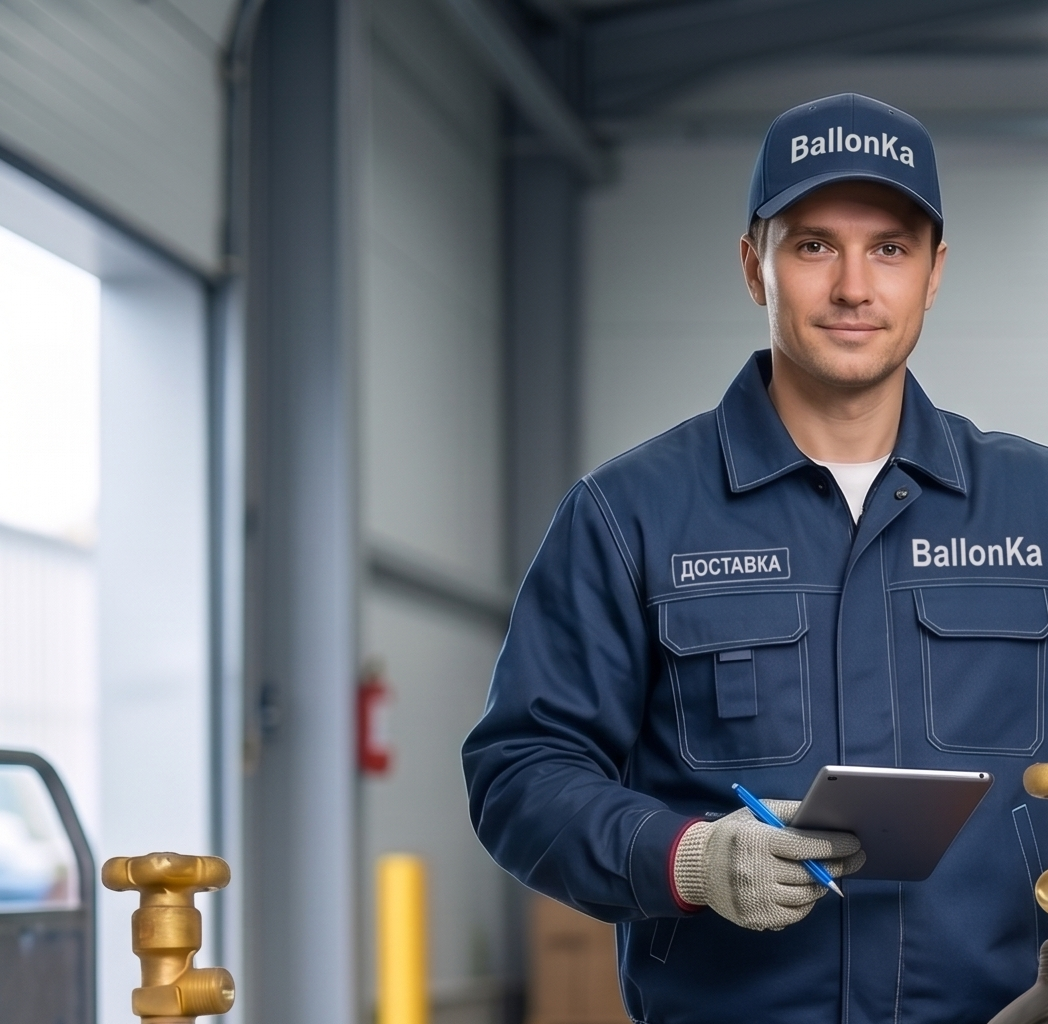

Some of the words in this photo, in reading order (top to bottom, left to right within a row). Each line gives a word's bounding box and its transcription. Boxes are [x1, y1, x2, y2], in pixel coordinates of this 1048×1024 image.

[791, 126, 915, 168] BallonKa
[911, 536, 1043, 567] BallonKa
[680, 554, 782, 582] ДОСТАВКА
